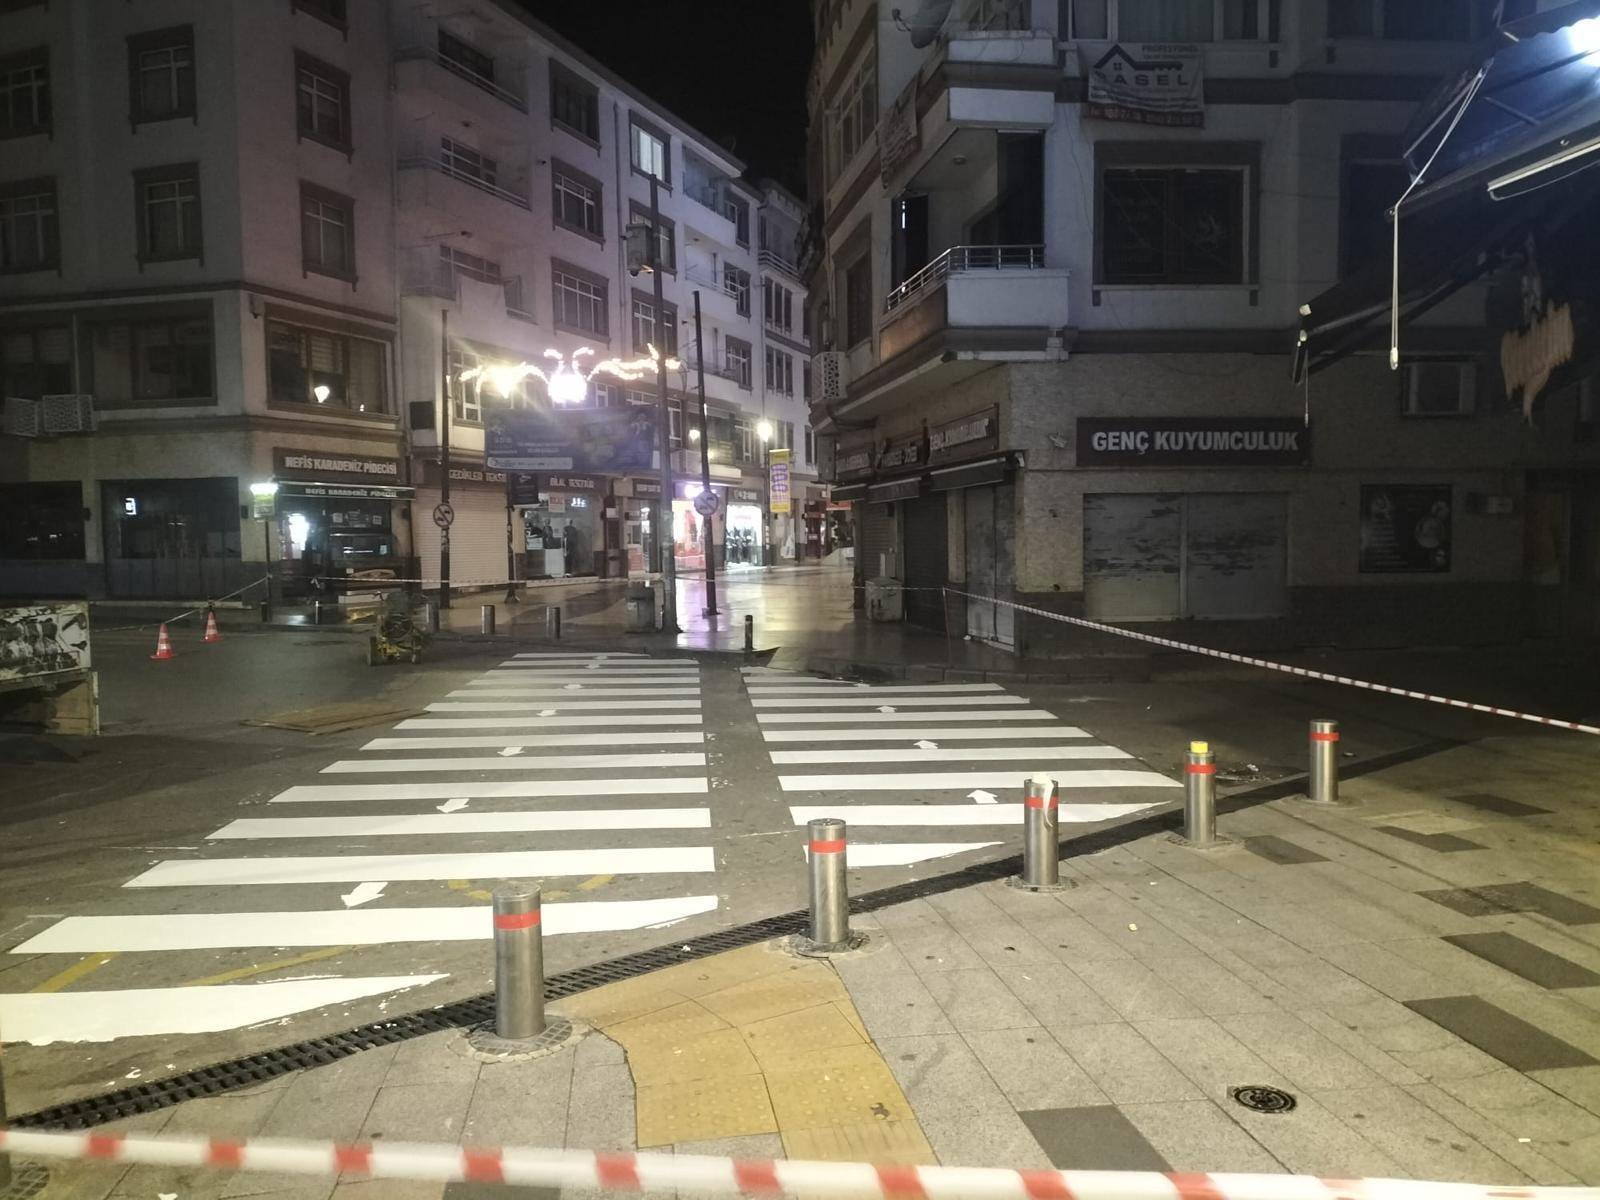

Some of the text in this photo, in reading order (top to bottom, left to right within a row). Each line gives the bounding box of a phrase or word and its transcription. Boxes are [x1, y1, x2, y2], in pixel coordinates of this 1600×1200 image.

[1092, 431, 1299, 454] GENÇ KUYUMCULUK
[284, 455, 397, 475] NEFİS KARADENİZ PİDECİSİ
